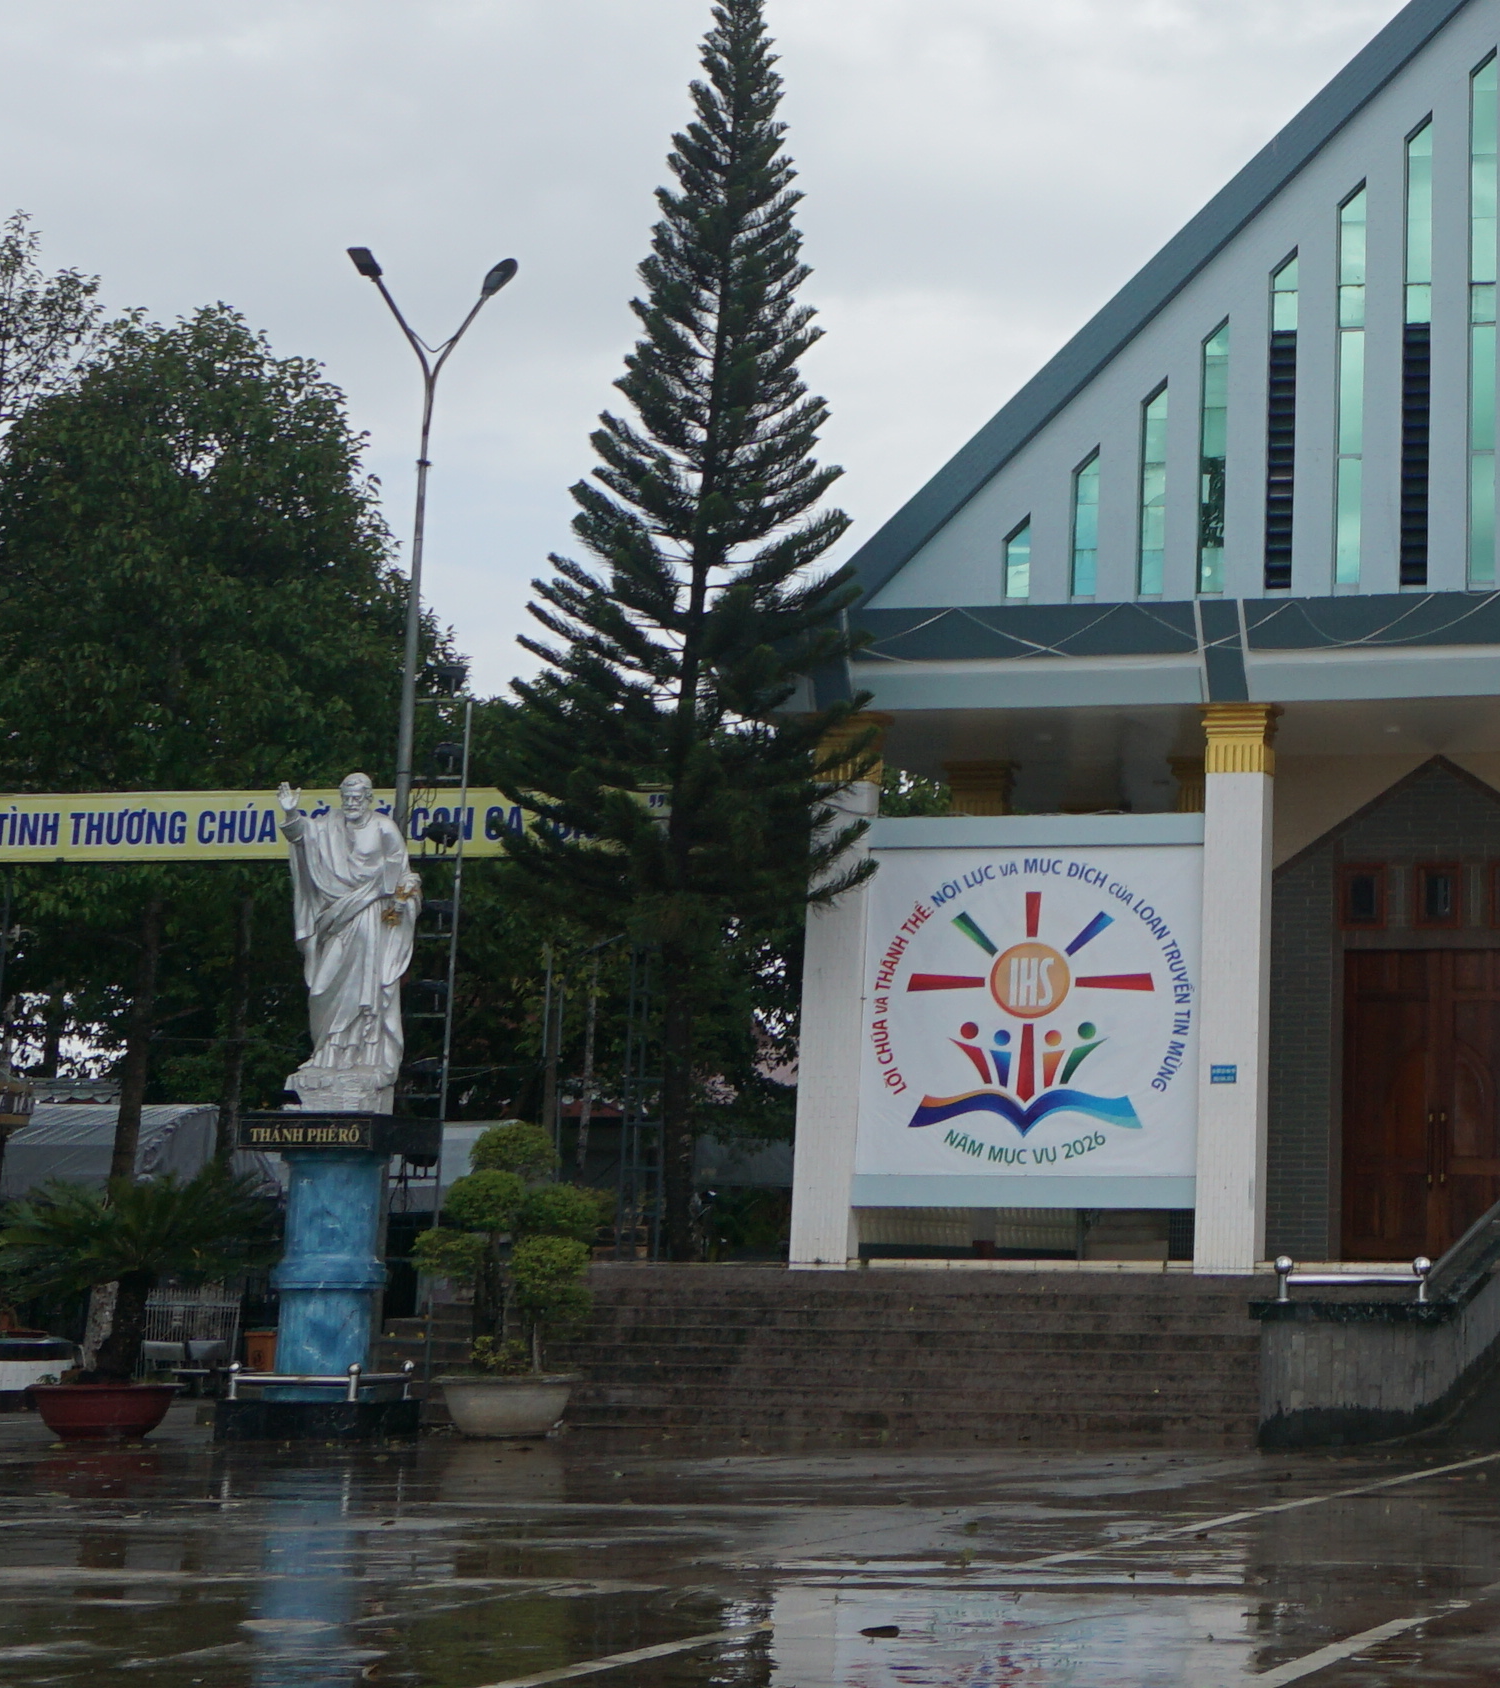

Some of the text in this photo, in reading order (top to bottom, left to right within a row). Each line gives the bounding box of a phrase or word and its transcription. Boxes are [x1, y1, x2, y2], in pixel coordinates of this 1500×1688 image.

[69, 807, 188, 846] THƯƠNG
[196, 802, 278, 845] CHÚA
[962, 864, 996, 889] LỰC
[1023, 857, 1063, 876] MỤC
[1066, 861, 1109, 889] ĐÍCH
[930, 879, 962, 908] NỘI
[1108, 881, 1134, 906] CỦA
[1132, 898, 1171, 941] LOAN
[874, 935, 910, 991] THÁNH
[1008, 957, 1055, 1007] IHS
[1161, 938, 1195, 1005] TRUYỀN
[870, 1018, 893, 1065] CHÚA
[1171, 1009, 1191, 1037] TIN
[1150, 1040, 1186, 1093] MỪNG
[250, 1123, 360, 1143] THÁNH PHÊRÔ
[943, 1128, 1107, 1167] NĂM MỤC VỤ 2026
